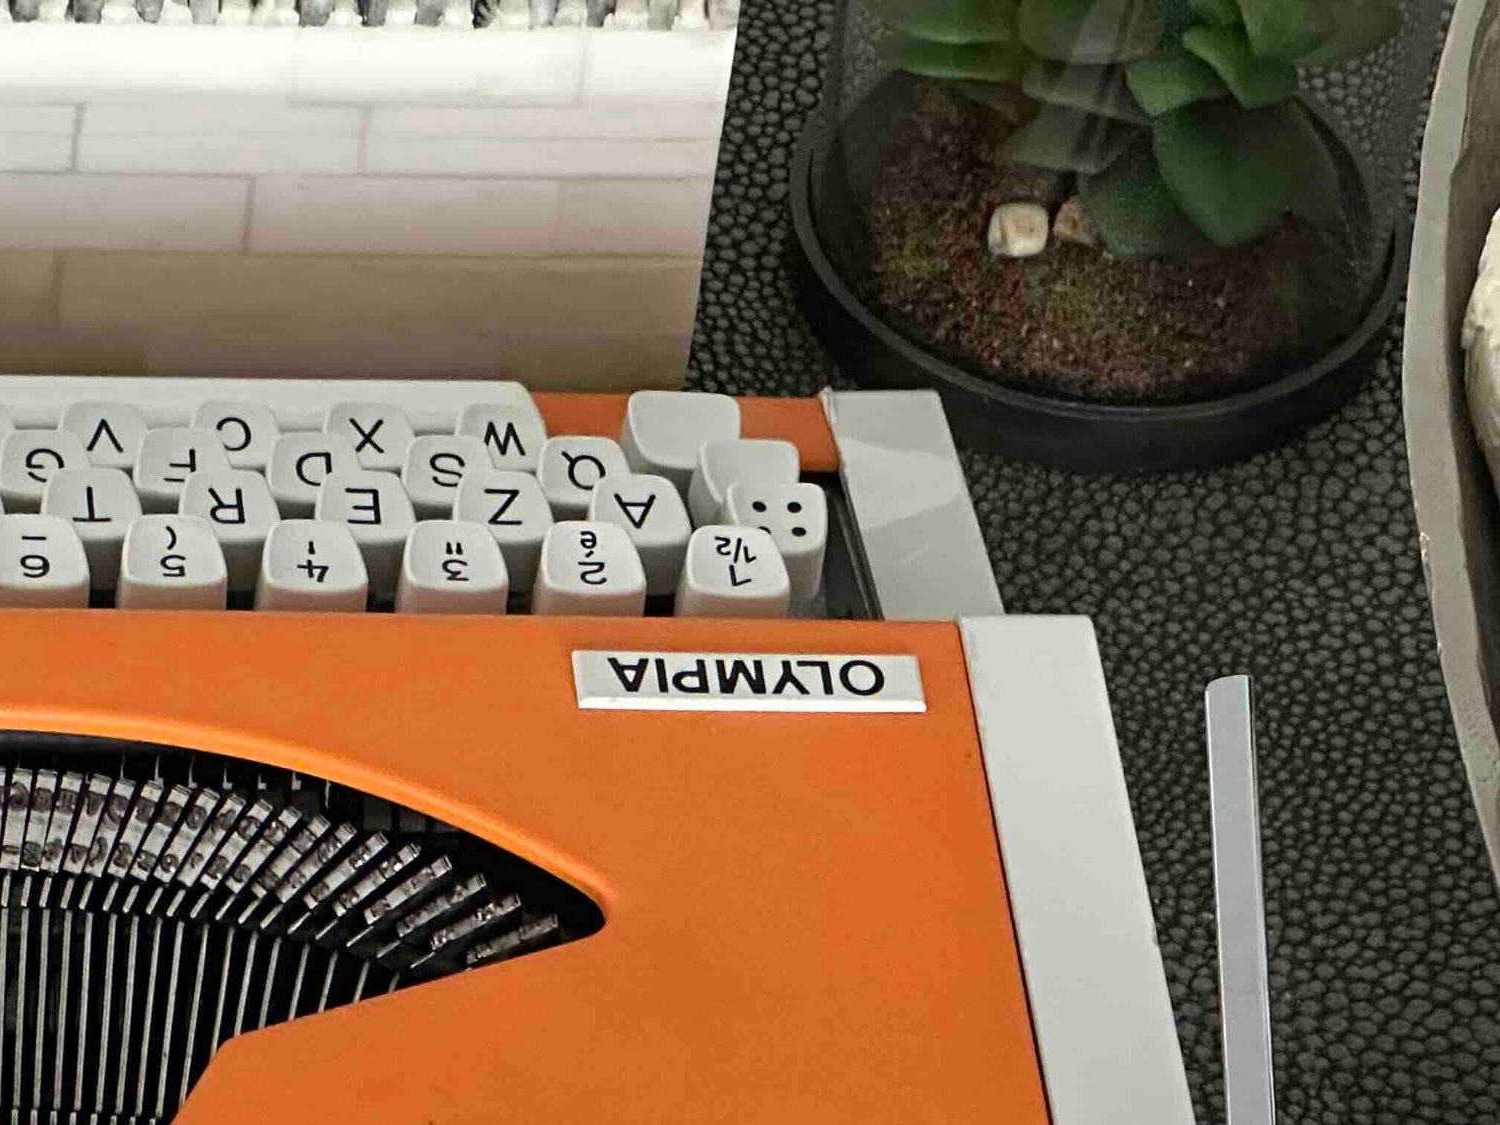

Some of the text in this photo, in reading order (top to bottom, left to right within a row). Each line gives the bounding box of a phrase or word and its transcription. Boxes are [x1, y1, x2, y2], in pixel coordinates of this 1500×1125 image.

[87, 419, 123, 452] V
[217, 417, 251, 451] C
[349, 418, 384, 453] X
[484, 422, 525, 456] W
[26, 448, 64, 482] G
[164, 449, 196, 482] F
[296, 452, 332, 486] D
[430, 453, 465, 487] S
[562, 451, 605, 490] Q
[73, 487, 111, 522] T
[208, 488, 245, 524] R
[345, 488, 381, 524] E
[484, 489, 522, 525] Z
[614, 494, 656, 529] A
[580, 531, 596, 558] é
[20, 555, 49, 578] 6
[160, 555, 186, 577] 5
[297, 560, 329, 582] 4
[442, 559, 468, 581] 3
[578, 562, 607, 584] 2
[608, 658, 884, 696] OLYMPIA
